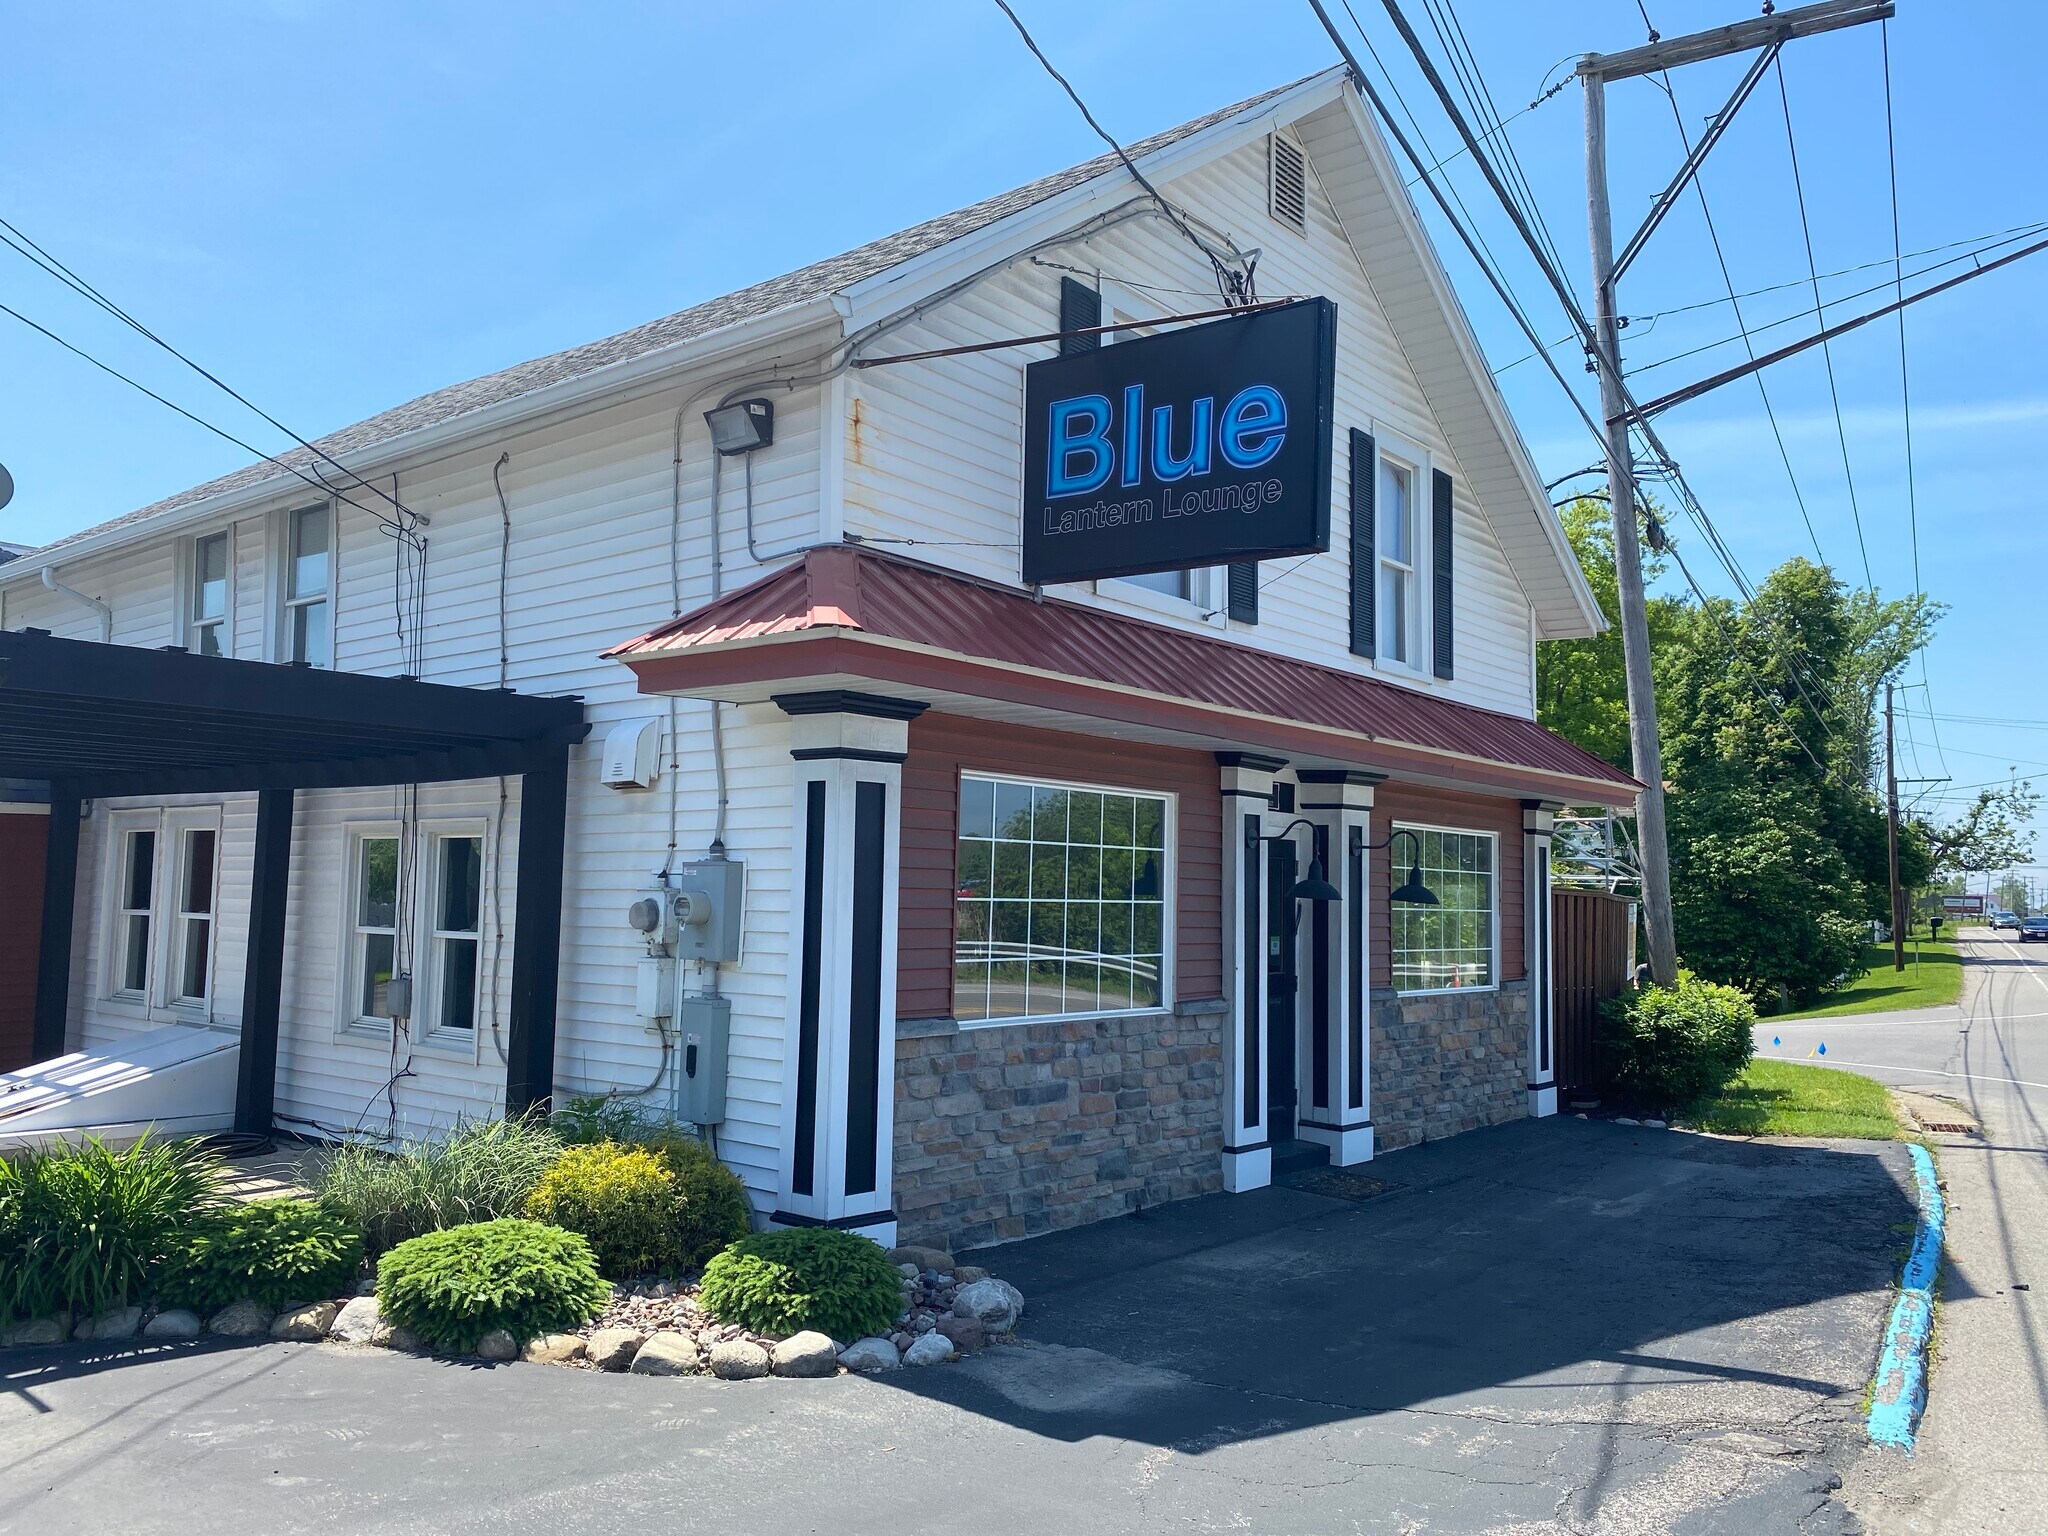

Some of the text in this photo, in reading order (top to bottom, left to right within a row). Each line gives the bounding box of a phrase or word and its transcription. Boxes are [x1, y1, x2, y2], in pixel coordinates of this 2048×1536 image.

[1046, 384, 1288, 499] Blue
[1043, 478, 1283, 536] Lantern Lounge
